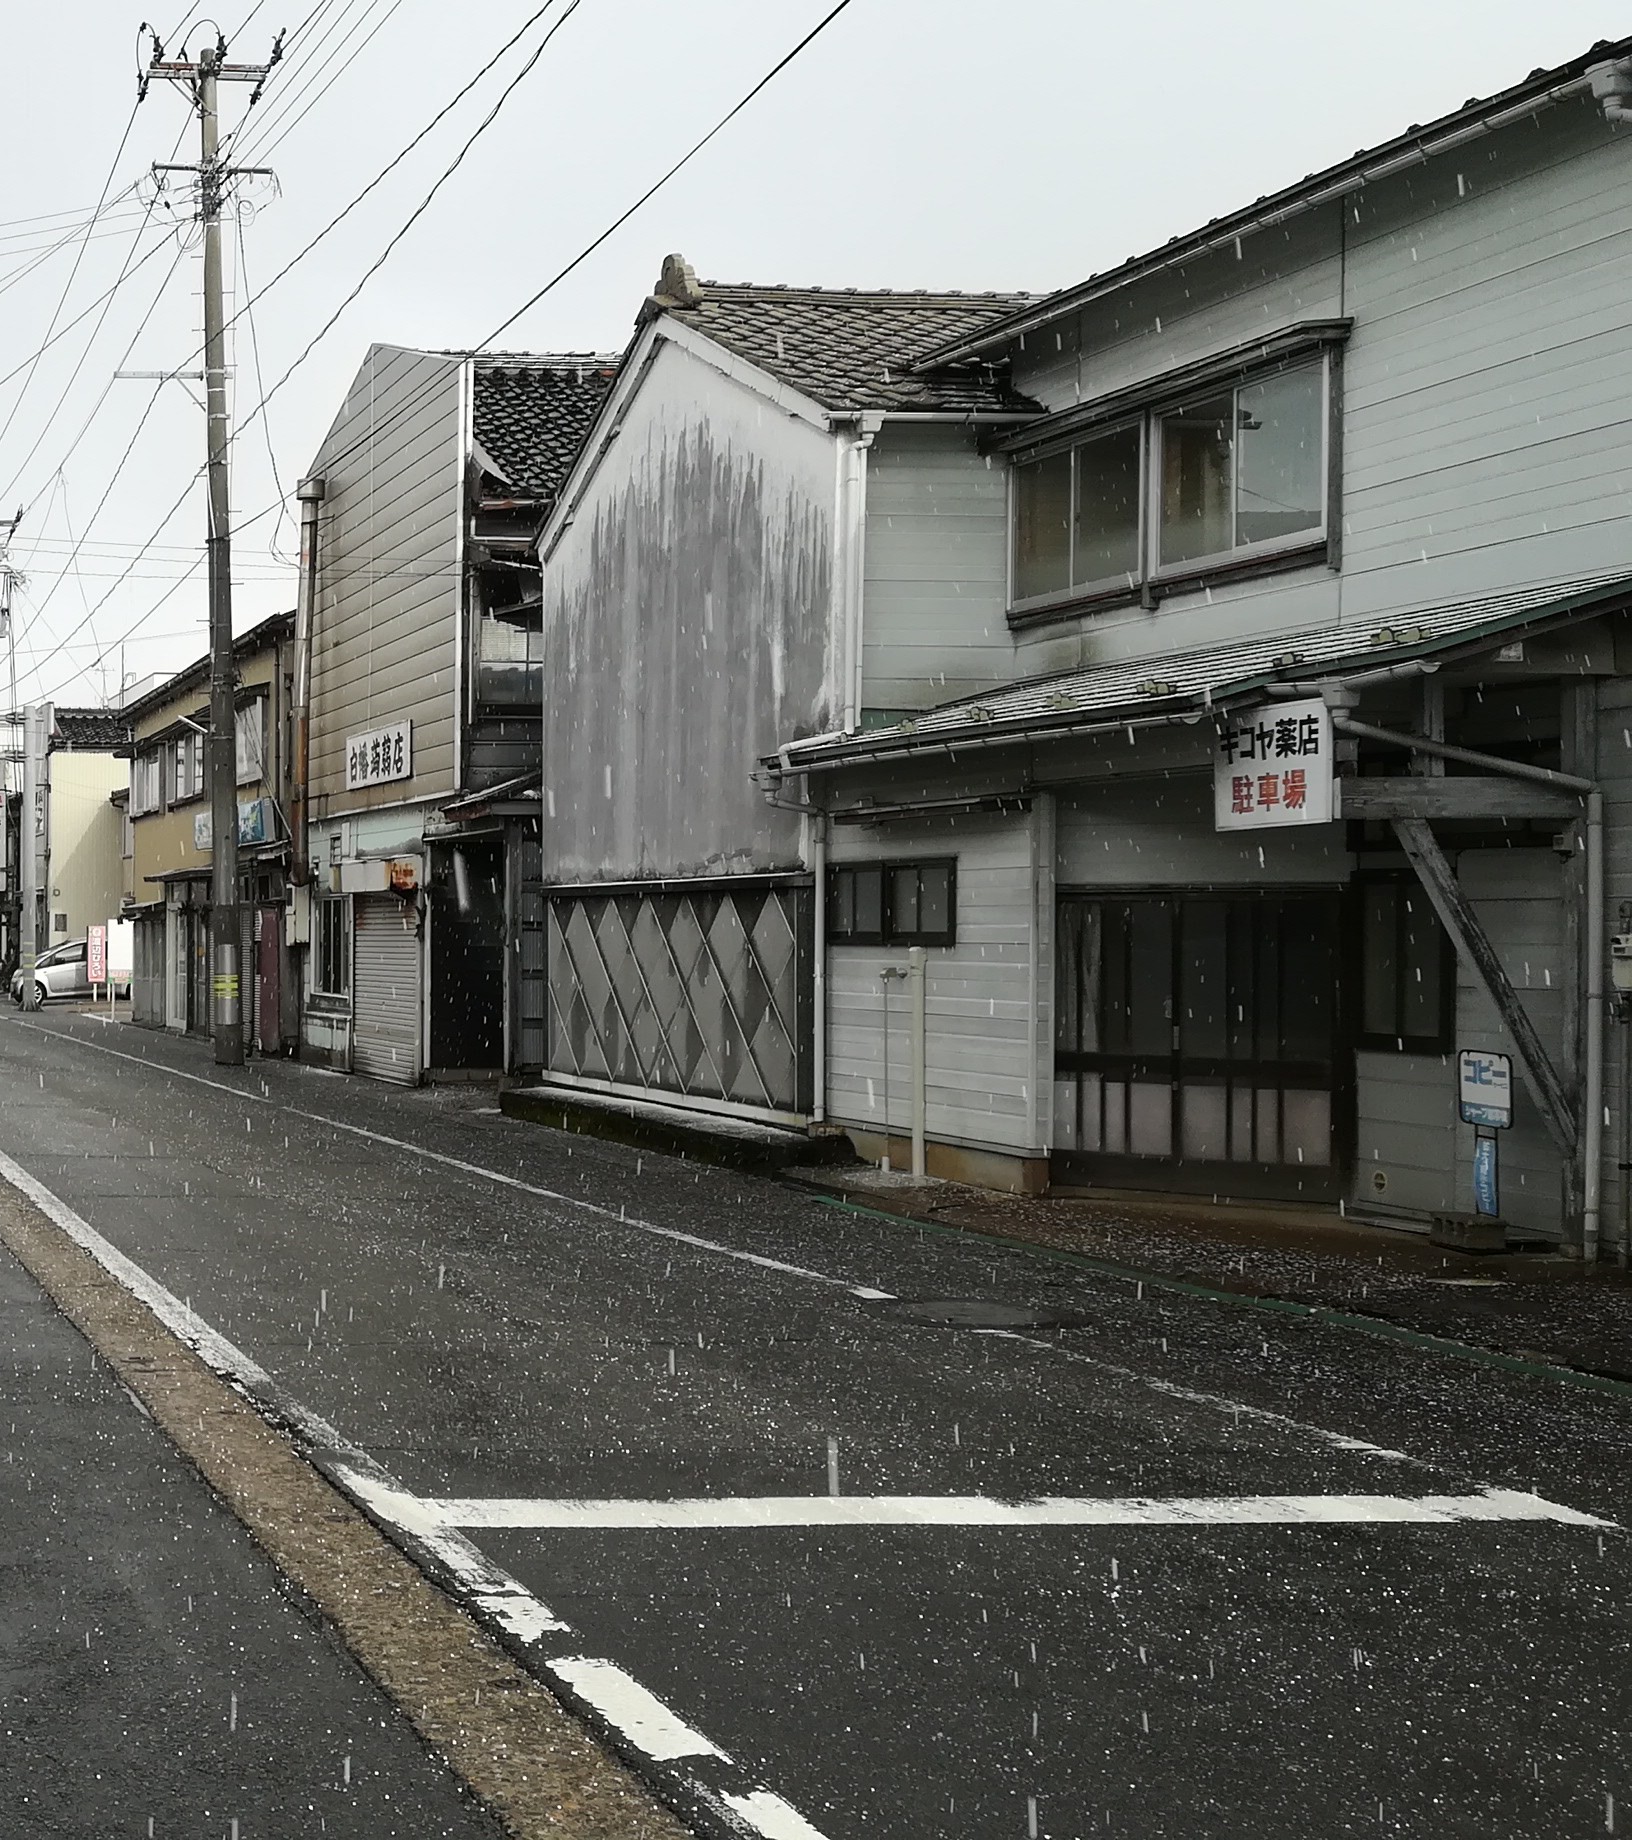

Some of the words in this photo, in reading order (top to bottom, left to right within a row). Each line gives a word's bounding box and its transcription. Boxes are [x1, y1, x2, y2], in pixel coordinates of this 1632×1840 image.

[1220, 714, 1320, 764] キコヤ薬店
[1231, 769, 1307, 814] 駐車場
